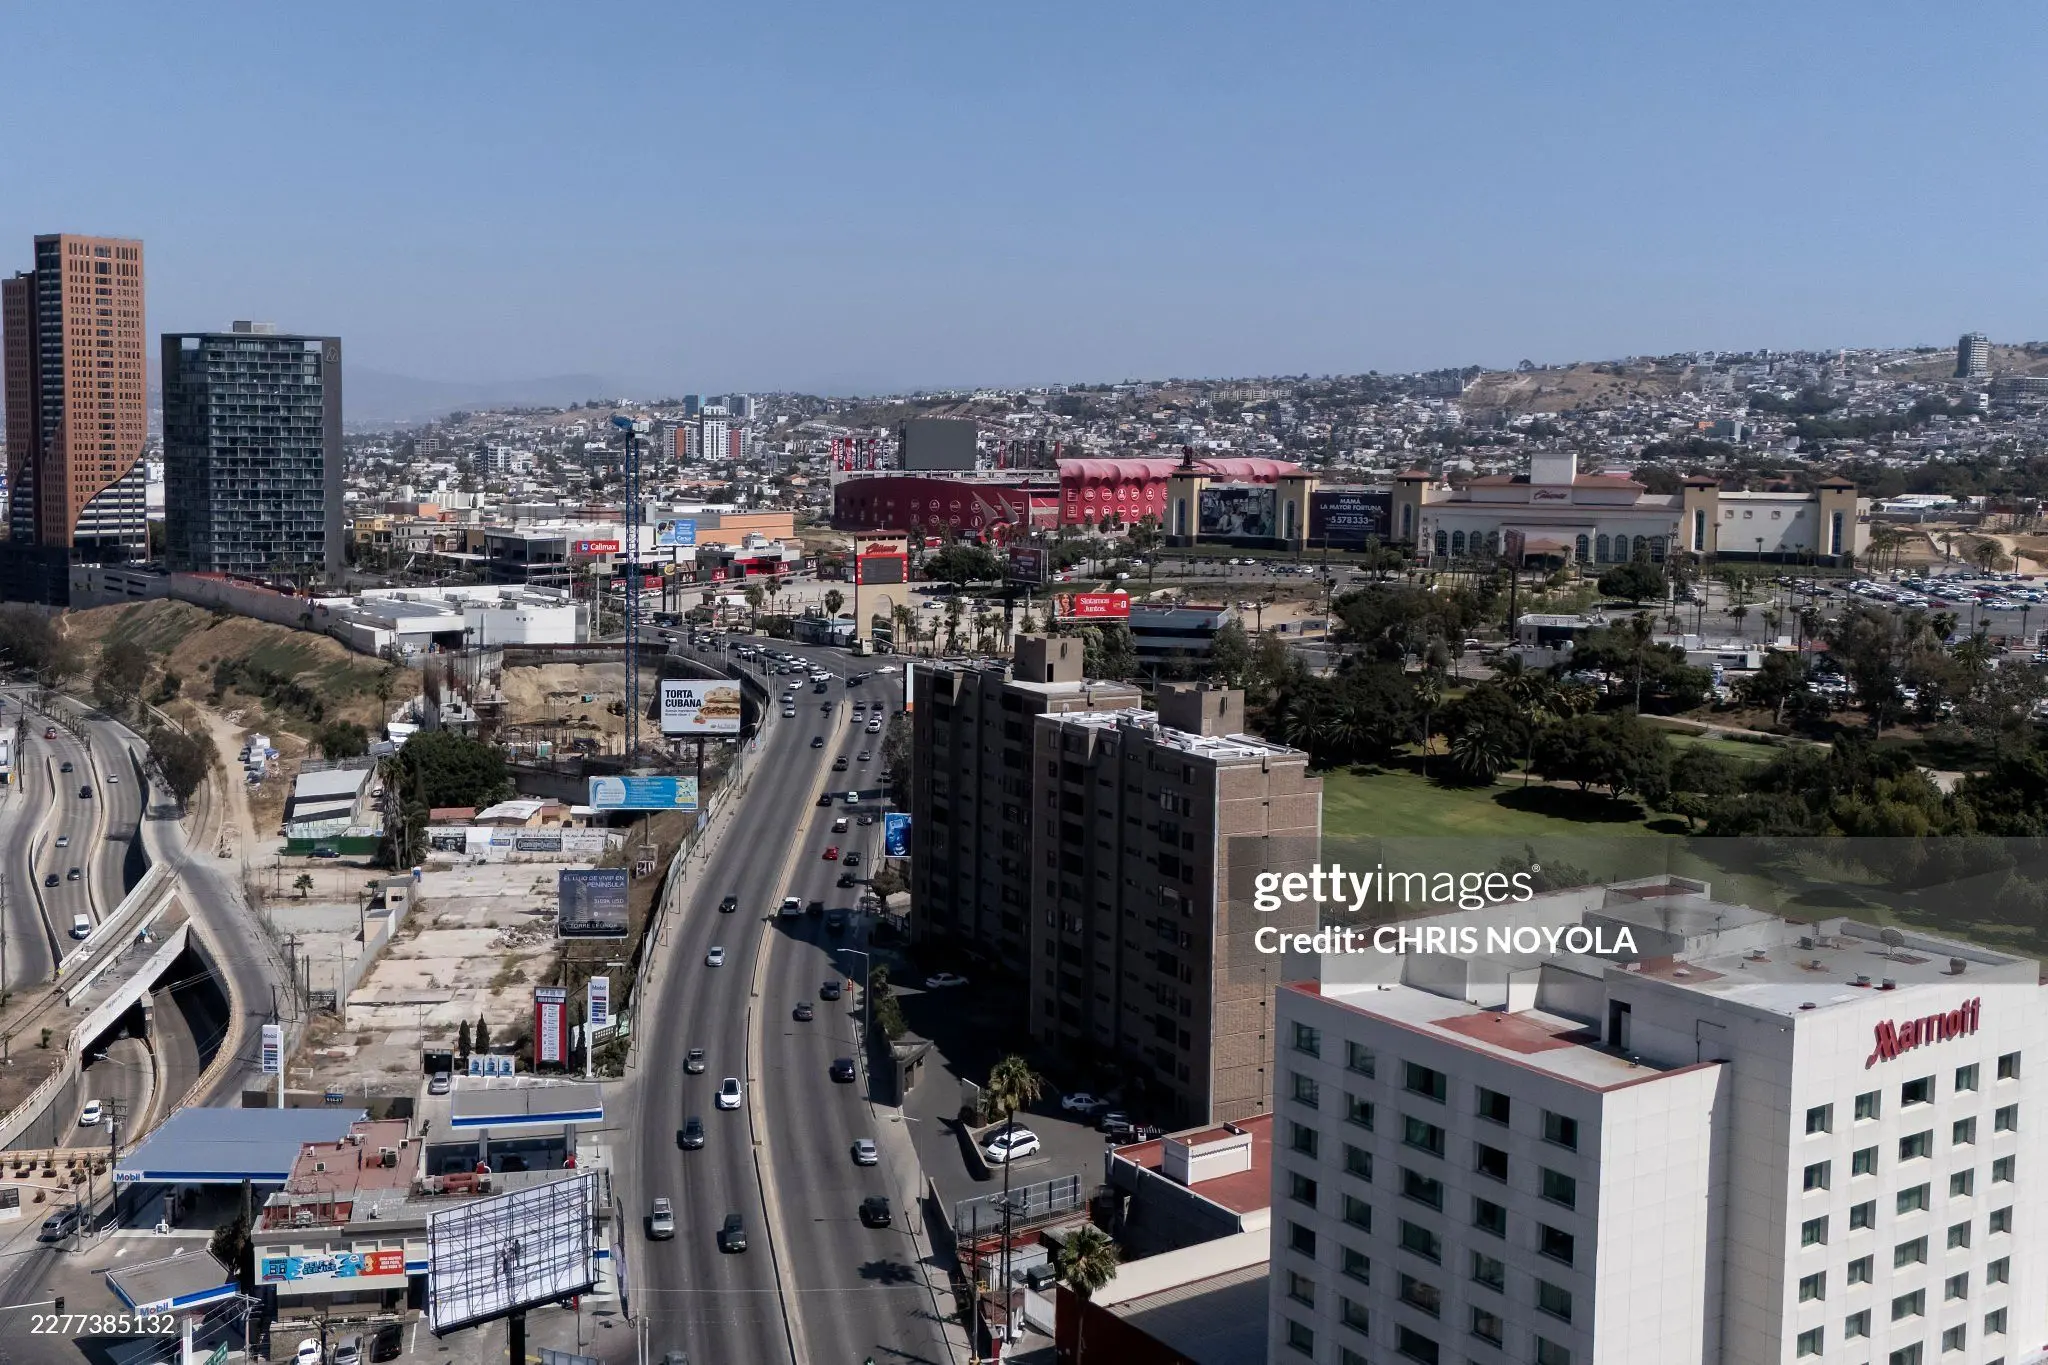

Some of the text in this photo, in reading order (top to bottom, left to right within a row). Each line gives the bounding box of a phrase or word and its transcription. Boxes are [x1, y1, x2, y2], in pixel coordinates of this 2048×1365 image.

[665, 690, 693, 698] TORTA
[665, 699, 702, 707] CUBANA
[1864, 997, 1981, 1069] Marriott
[116, 1173, 141, 1181] Mobil
[140, 1301, 169, 1316] Mobil
